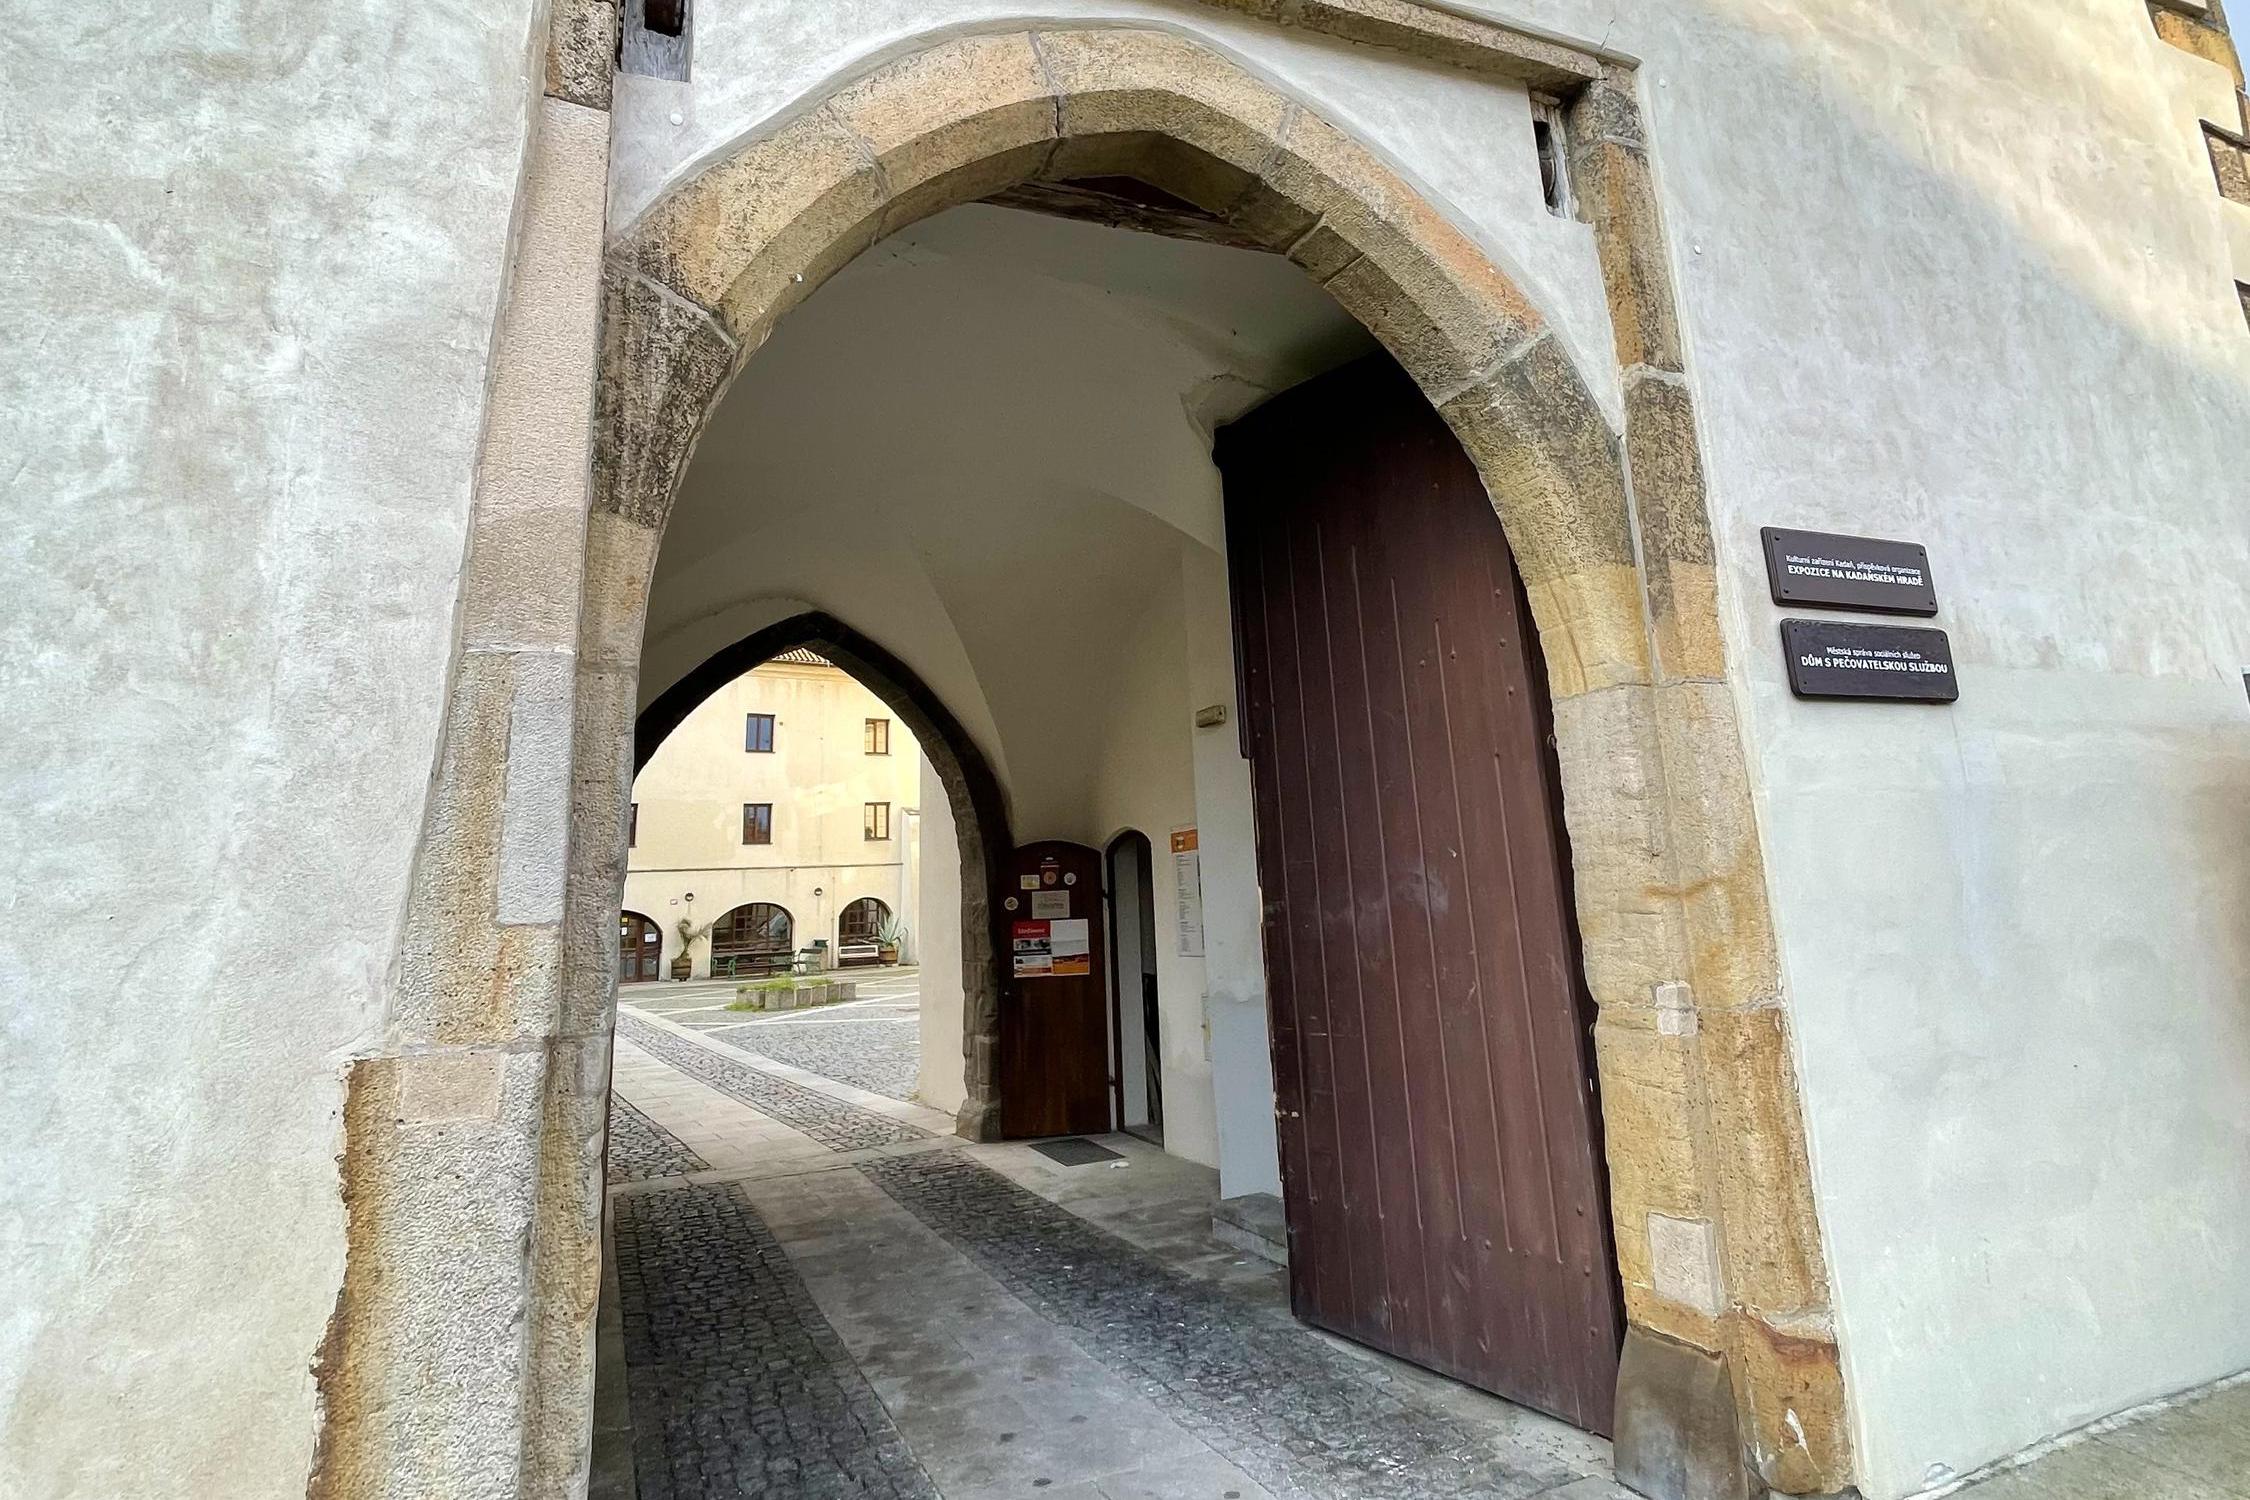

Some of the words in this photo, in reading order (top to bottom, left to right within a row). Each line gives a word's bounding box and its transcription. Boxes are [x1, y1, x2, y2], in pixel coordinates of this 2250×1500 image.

[1788, 565, 1831, 577] EXPOZICE
[1832, 569, 1845, 579] NA
[1846, 570, 1895, 584] KADAŇSKÉM
[1896, 575, 1924, 586] HRADĚ
[1801, 653, 1823, 667] DŮM
[1825, 657, 1832, 667] S
[1833, 656, 1907, 671] PEČOVATELSKOU
[1908, 660, 1948, 673] SLUŽBOU
